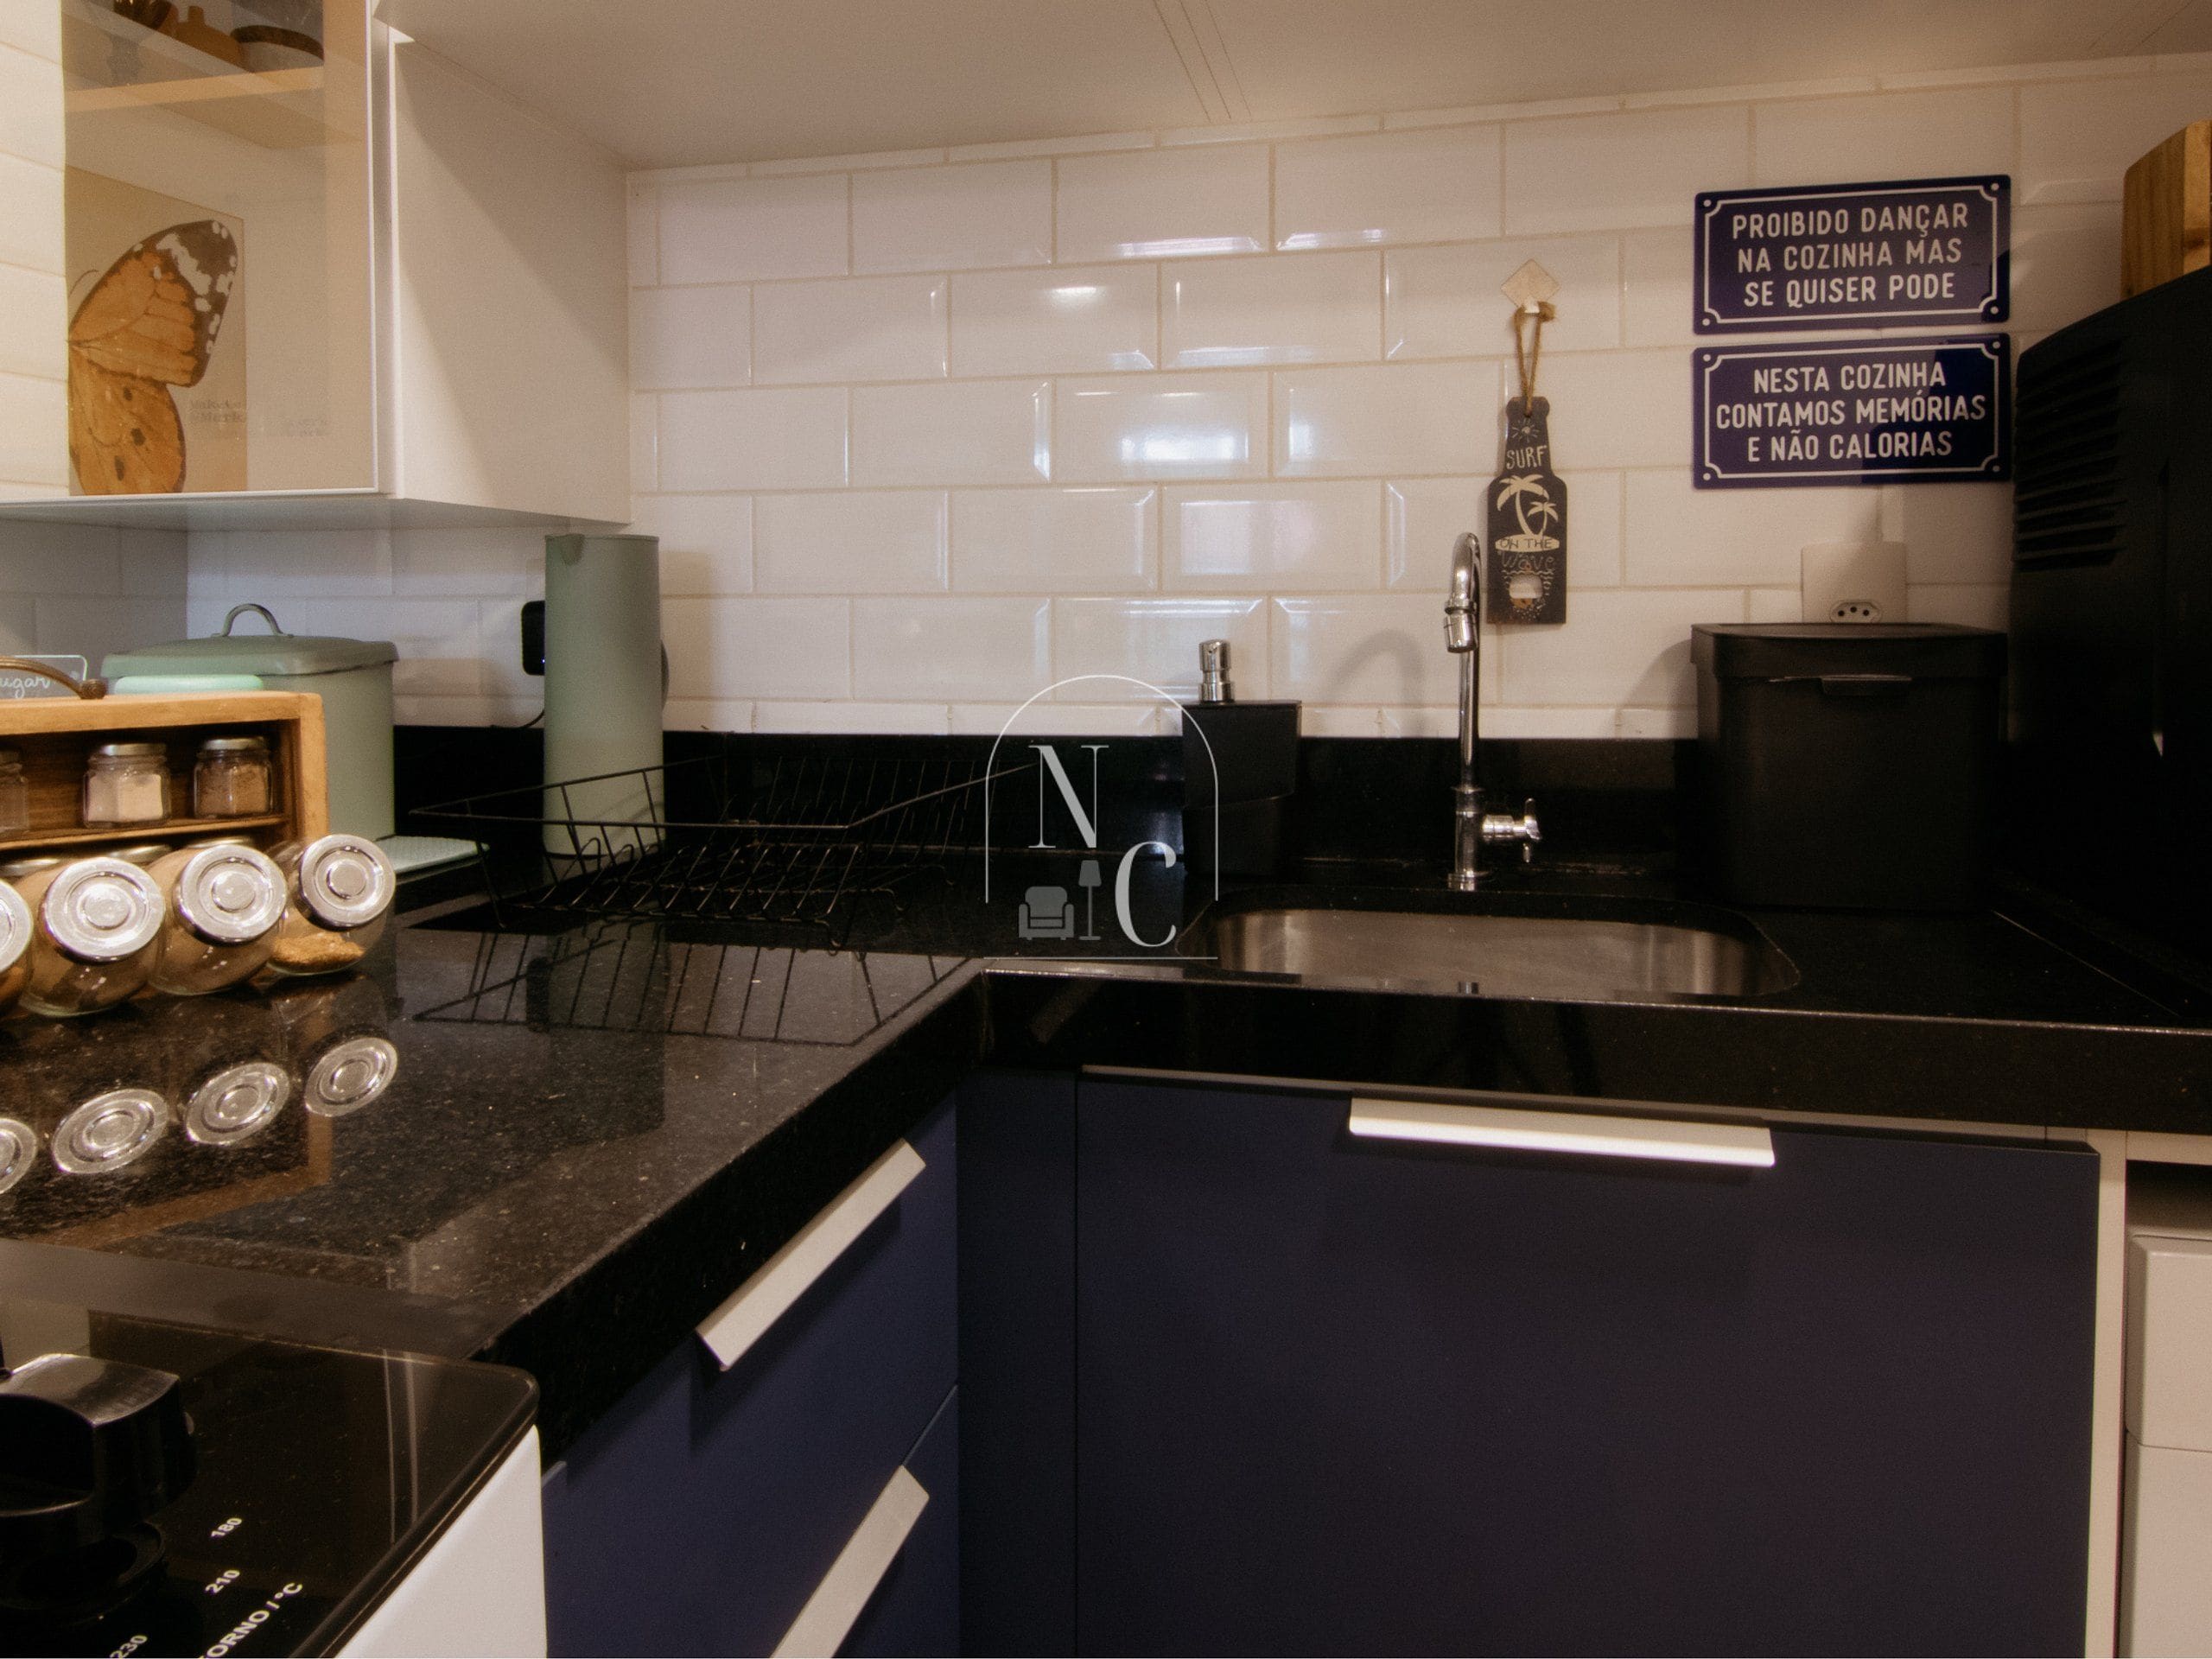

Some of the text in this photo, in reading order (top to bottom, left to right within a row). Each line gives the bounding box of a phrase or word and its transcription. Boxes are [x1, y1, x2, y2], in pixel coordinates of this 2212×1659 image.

[1732, 202, 1968, 239] PROIBIDO DANÇAR
[1738, 238, 1961, 273] NA COZINHA MAS
[1744, 272, 1955, 308] SE QUISER PODE
[1754, 361, 1946, 393] NESTA COZINHA
[1716, 389, 1986, 429] CONTAMOS MEMÓRIAS
[1506, 445, 1548, 469] SURF
[1747, 429, 1953, 462] E NÃO CALORIAS
[1499, 537, 1553, 550] ON THE
[0, 676, 50, 698] ugar
[211, 1517, 242, 1538] 180
[204, 1569, 240, 1594] 210
[198, 1610, 270, 1658] ORNO
[274, 1583, 303, 1599] °C
[110, 1635, 148, 1658] 230
